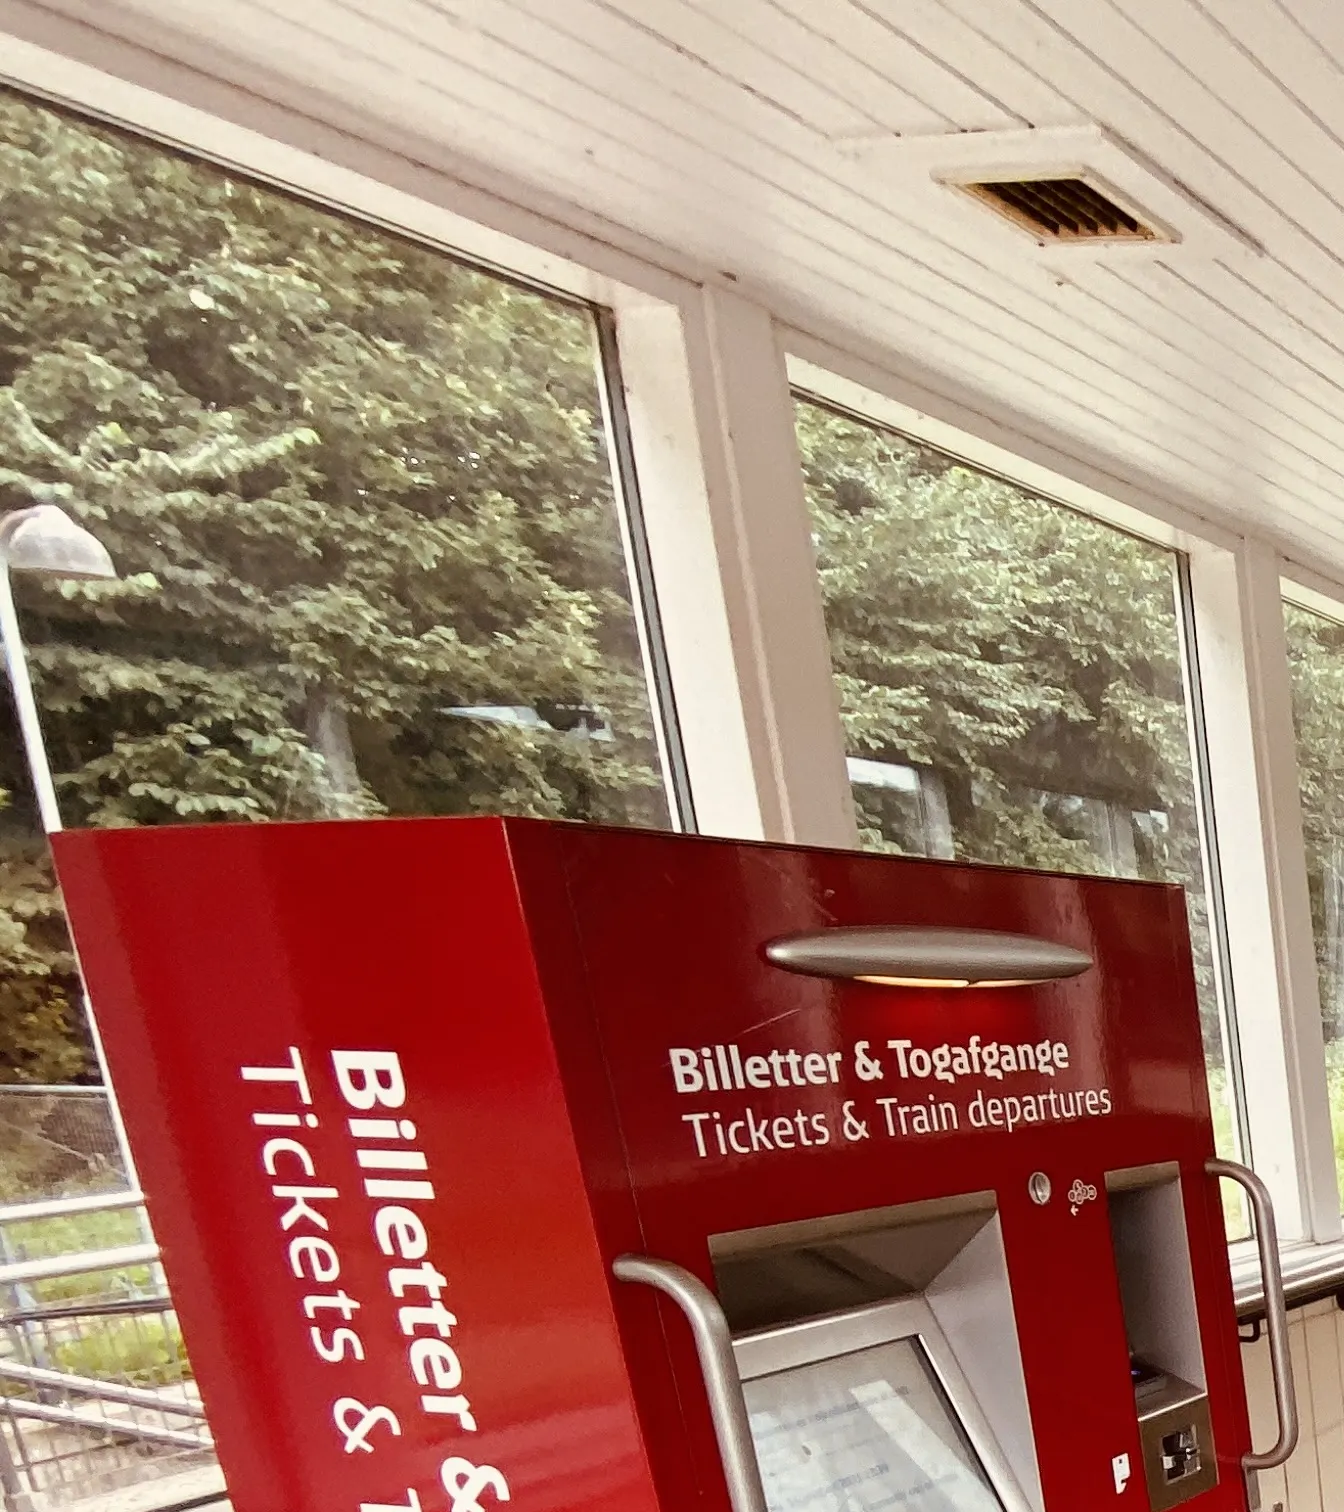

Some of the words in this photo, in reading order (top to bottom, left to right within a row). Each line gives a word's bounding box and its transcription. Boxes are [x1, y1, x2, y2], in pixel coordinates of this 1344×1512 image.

[668, 1044, 843, 1094] Billetter
[854, 1040, 884, 1082] &
[887, 1035, 1070, 1083] Togafgange
[681, 1107, 830, 1158] Tickets
[842, 1100, 870, 1141] &
[876, 1095, 959, 1137] Train
[968, 1086, 1112, 1133] departures
[241, 1046, 365, 1362] Tickets
[333, 1397, 401, 1454] &
[331, 1050, 477, 1432] Billetter
